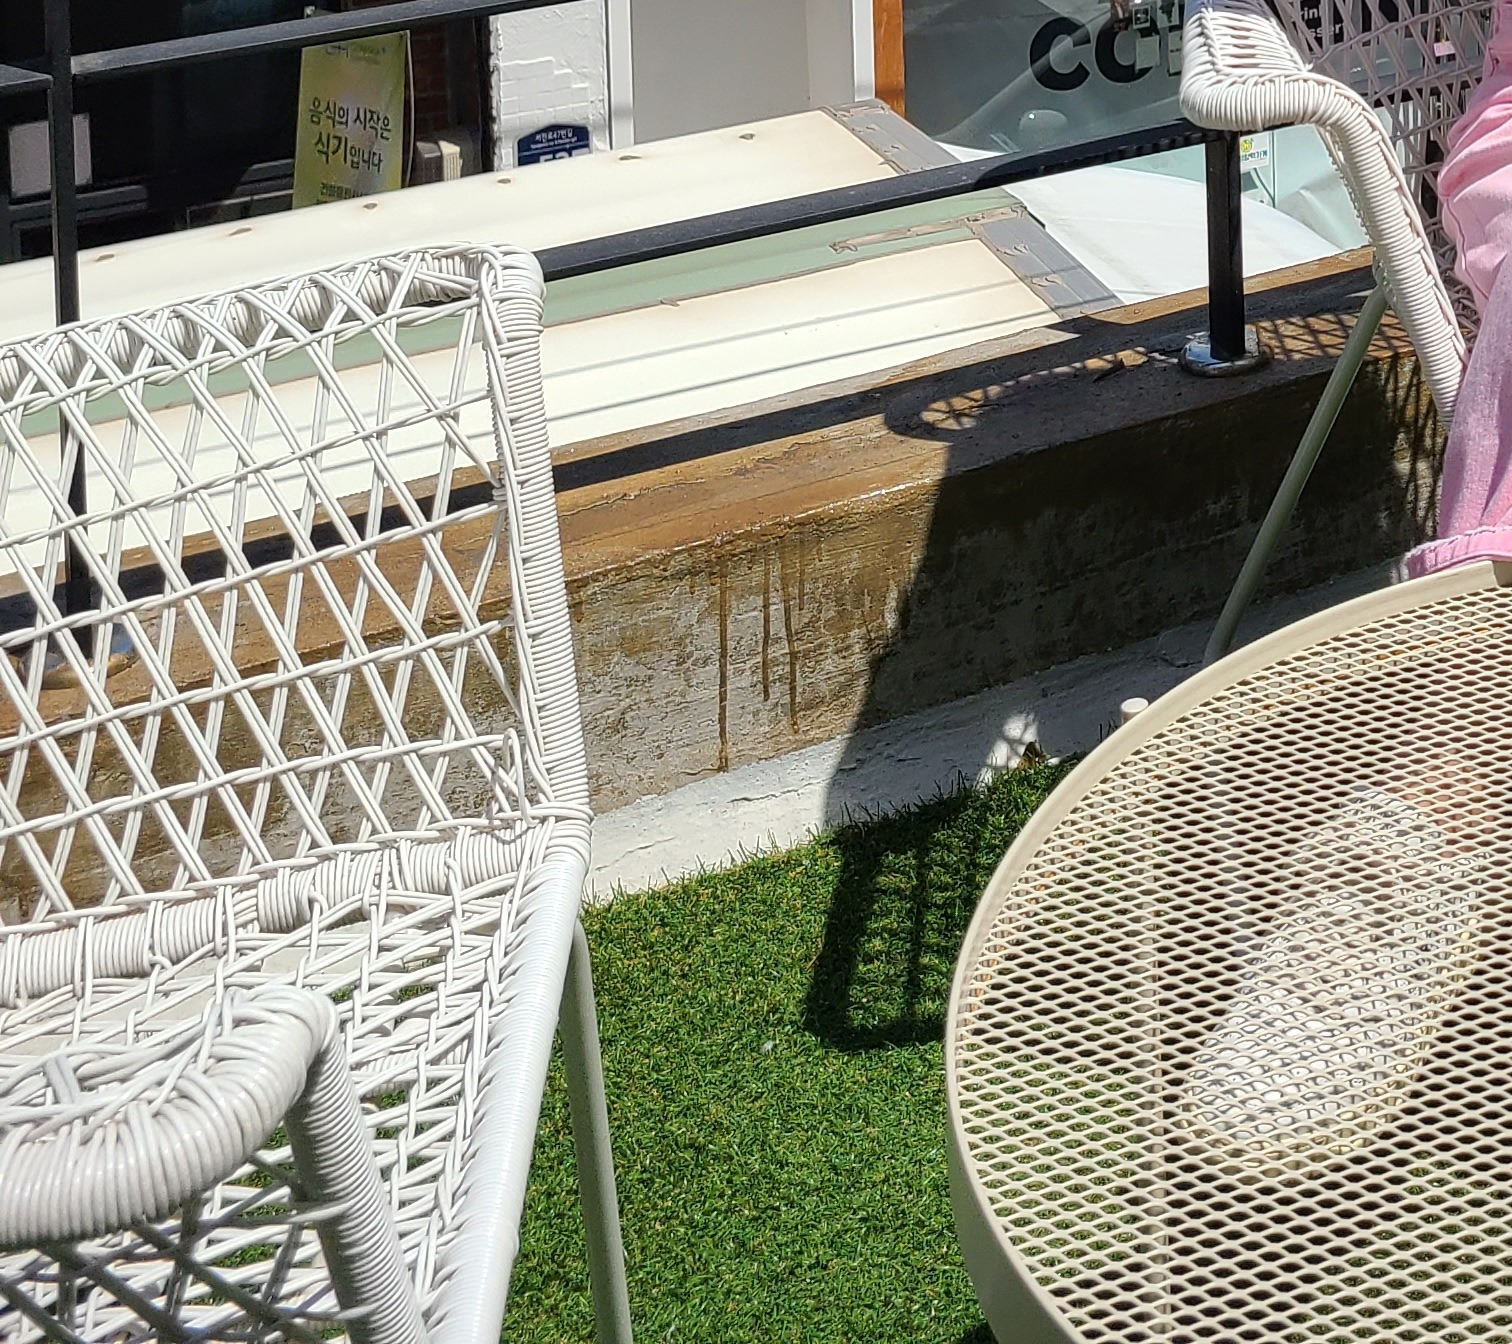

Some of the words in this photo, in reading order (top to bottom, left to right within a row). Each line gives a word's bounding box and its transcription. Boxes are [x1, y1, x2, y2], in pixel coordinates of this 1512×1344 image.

[309, 97, 349, 128] 음식의
[354, 107, 391, 141] 시작은
[315, 131, 383, 174] 식기입니다
